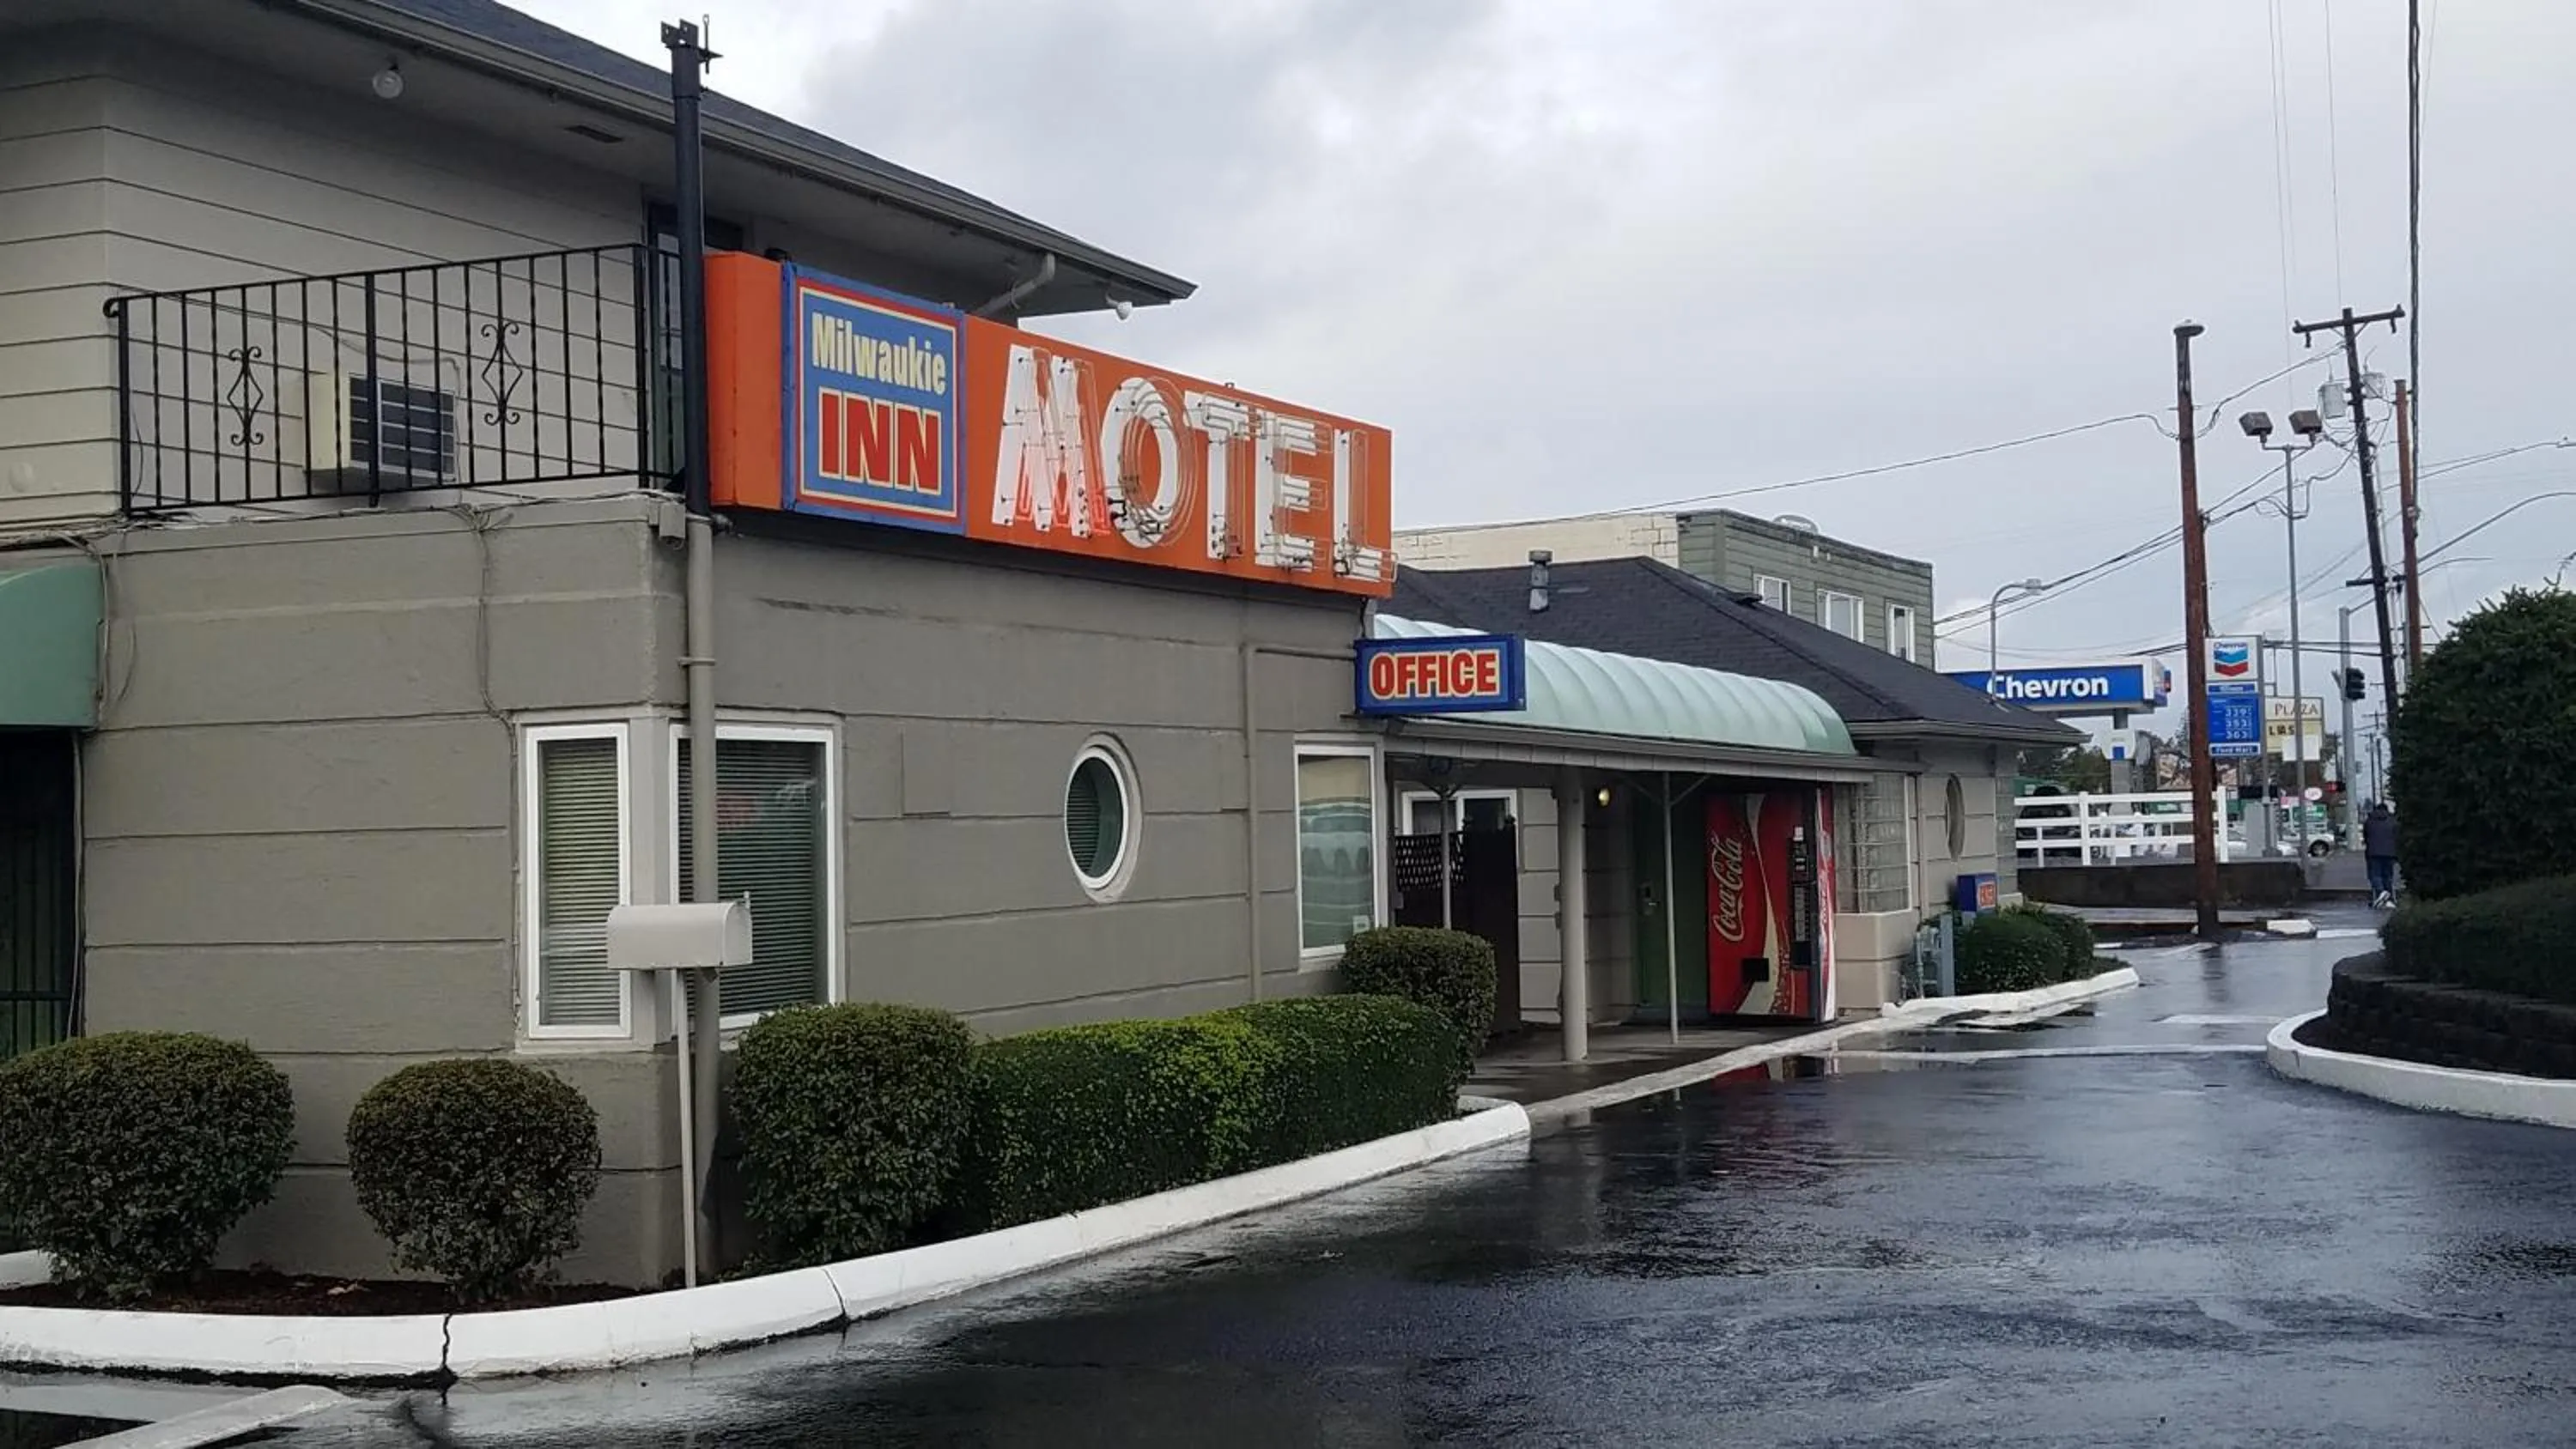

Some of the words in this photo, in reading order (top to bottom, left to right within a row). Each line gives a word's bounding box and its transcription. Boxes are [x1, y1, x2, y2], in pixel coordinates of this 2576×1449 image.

[812, 312, 945, 395] Milwaukie
[819, 386, 942, 496] INN
[992, 343, 1389, 583] MOTEL
[1369, 649, 1500, 700] OFFICE
[1986, 674, 2108, 700] Chevron
[2275, 703, 2319, 716] PLZA
